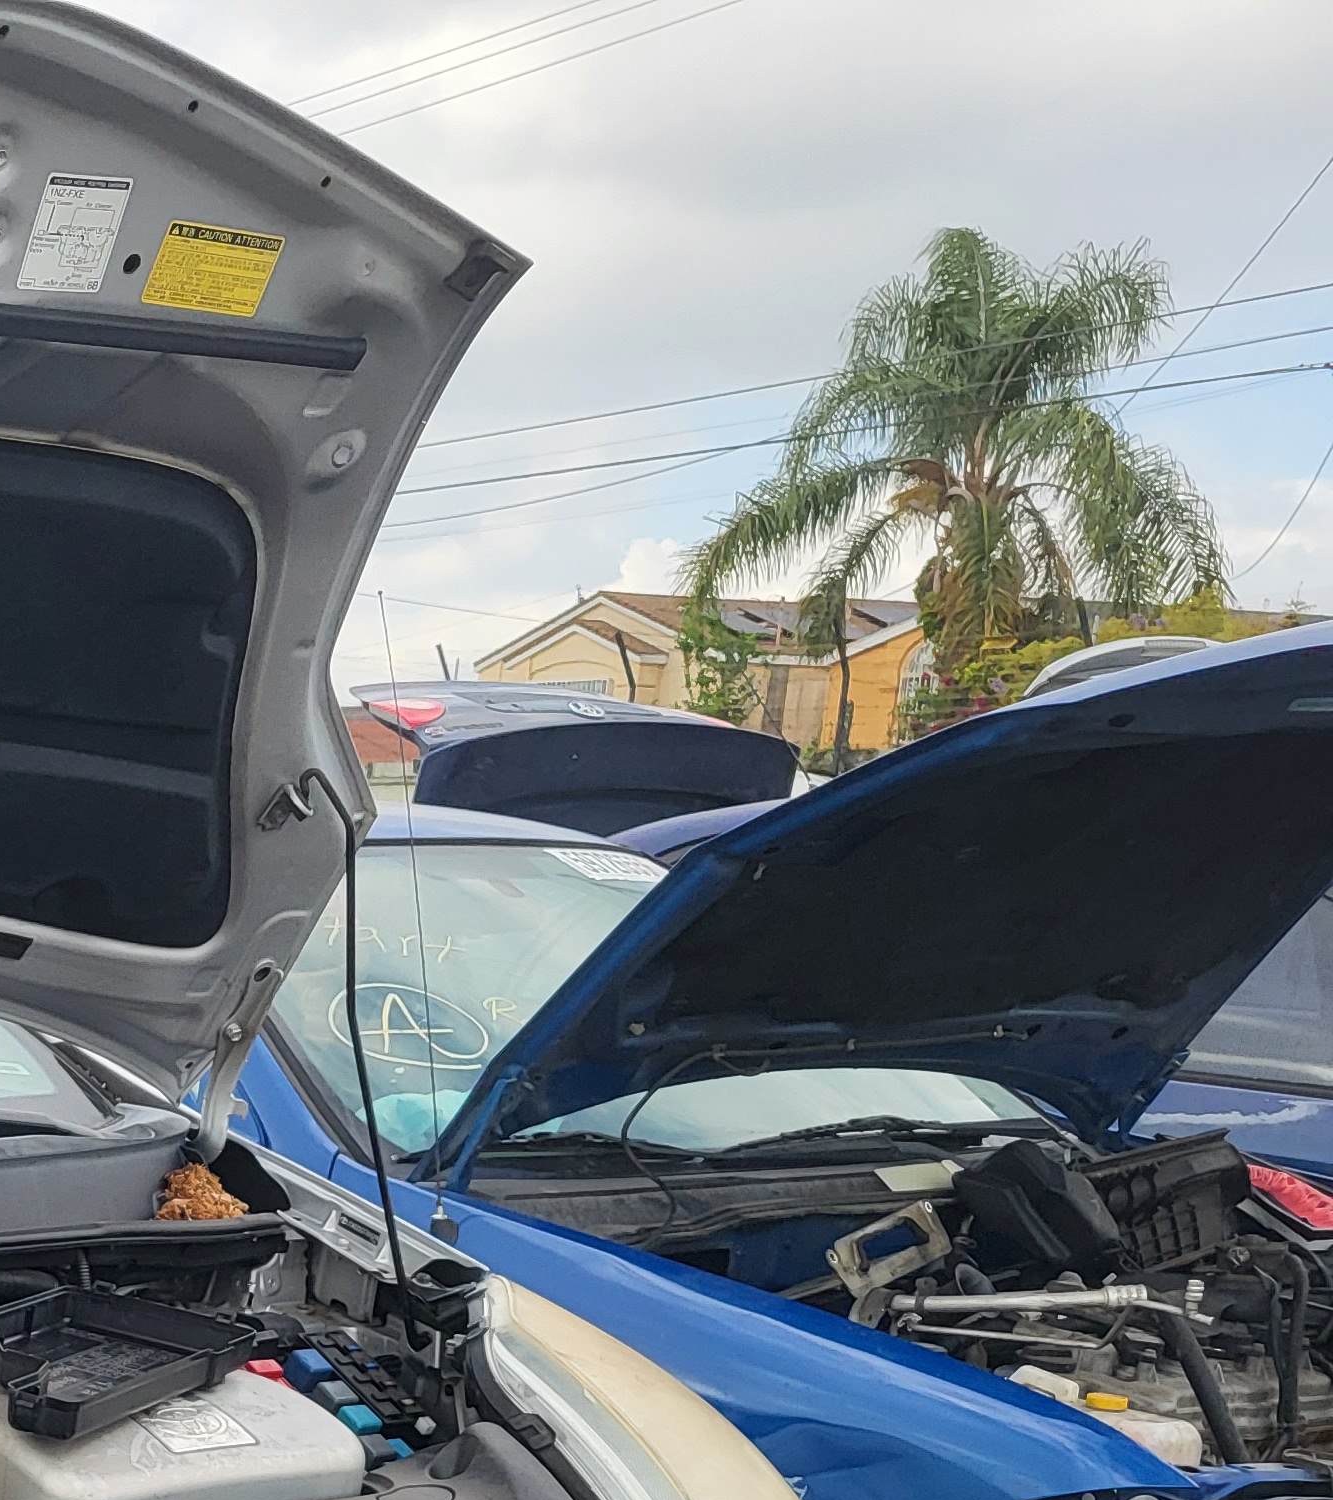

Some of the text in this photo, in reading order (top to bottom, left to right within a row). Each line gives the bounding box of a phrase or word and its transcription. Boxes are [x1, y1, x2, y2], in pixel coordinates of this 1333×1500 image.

[198, 229, 234, 243] CAUTION
[235, 235, 280, 250] ATTENTION
[323, 916, 469, 965] tart
